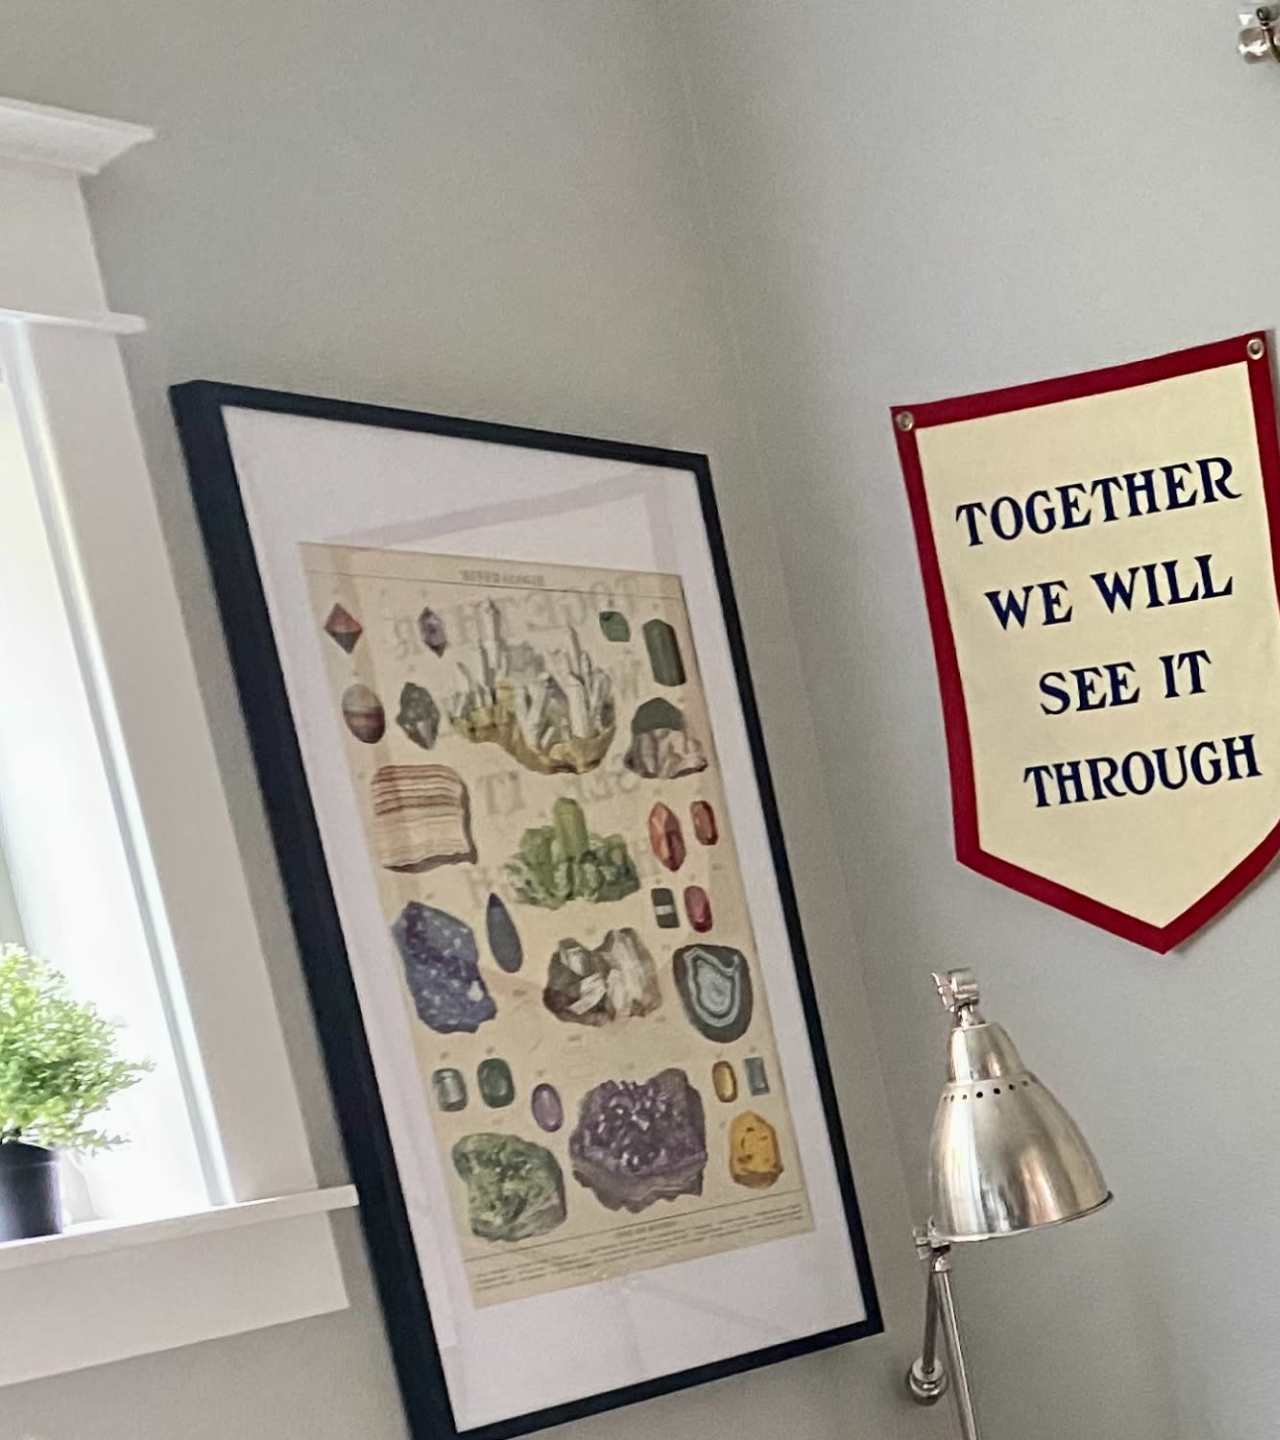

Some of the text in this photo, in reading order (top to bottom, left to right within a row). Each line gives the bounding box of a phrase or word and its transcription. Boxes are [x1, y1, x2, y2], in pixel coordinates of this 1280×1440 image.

[954, 455, 1243, 548] TOGETHER
[984, 553, 1234, 632] WE WILL
[1038, 648, 1213, 717] SEE IT
[1022, 733, 1263, 809] THROUGH
